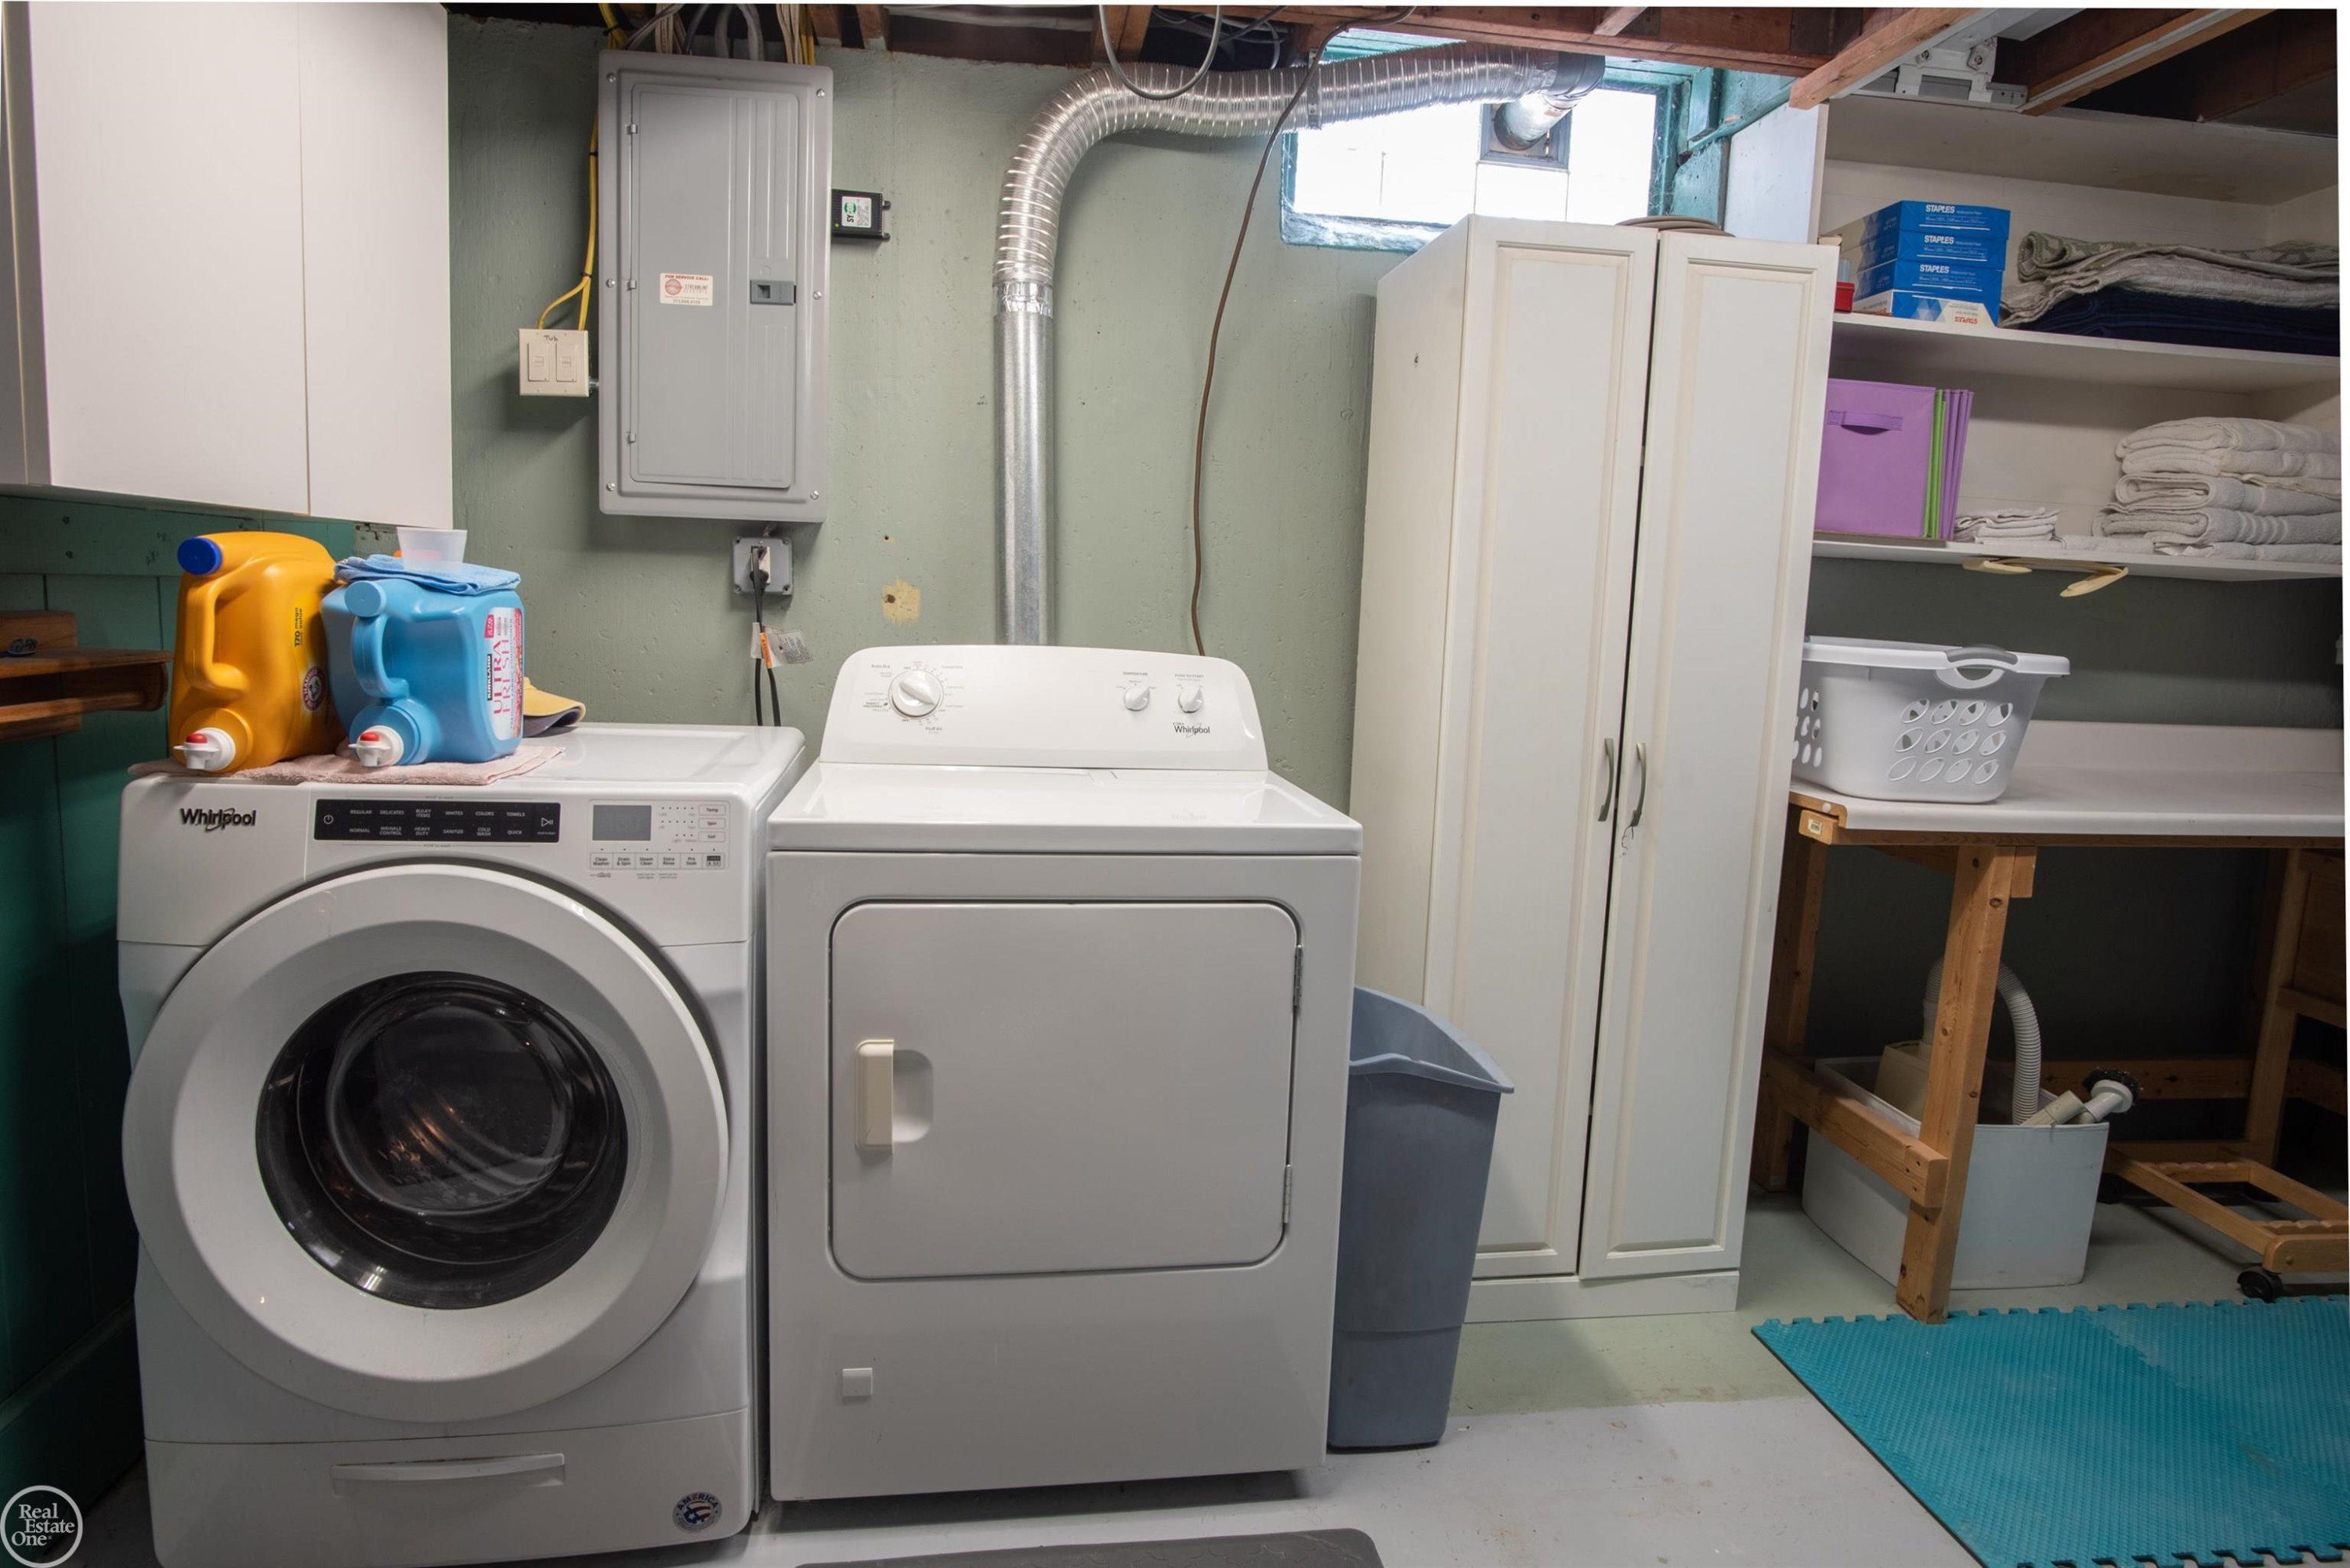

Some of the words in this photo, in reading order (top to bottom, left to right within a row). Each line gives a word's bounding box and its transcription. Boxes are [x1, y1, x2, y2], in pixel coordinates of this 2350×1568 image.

[1925, 204, 1955, 214] STAPLES
[1924, 234, 1954, 244] STAPLES
[1919, 264, 1950, 273] STAPLES
[493, 640, 502, 714] ULTRA
[1174, 725, 1210, 735] Whirlpool
[180, 807, 257, 829] Whirlpool
[677, 1493, 719, 1510] AMERICA
